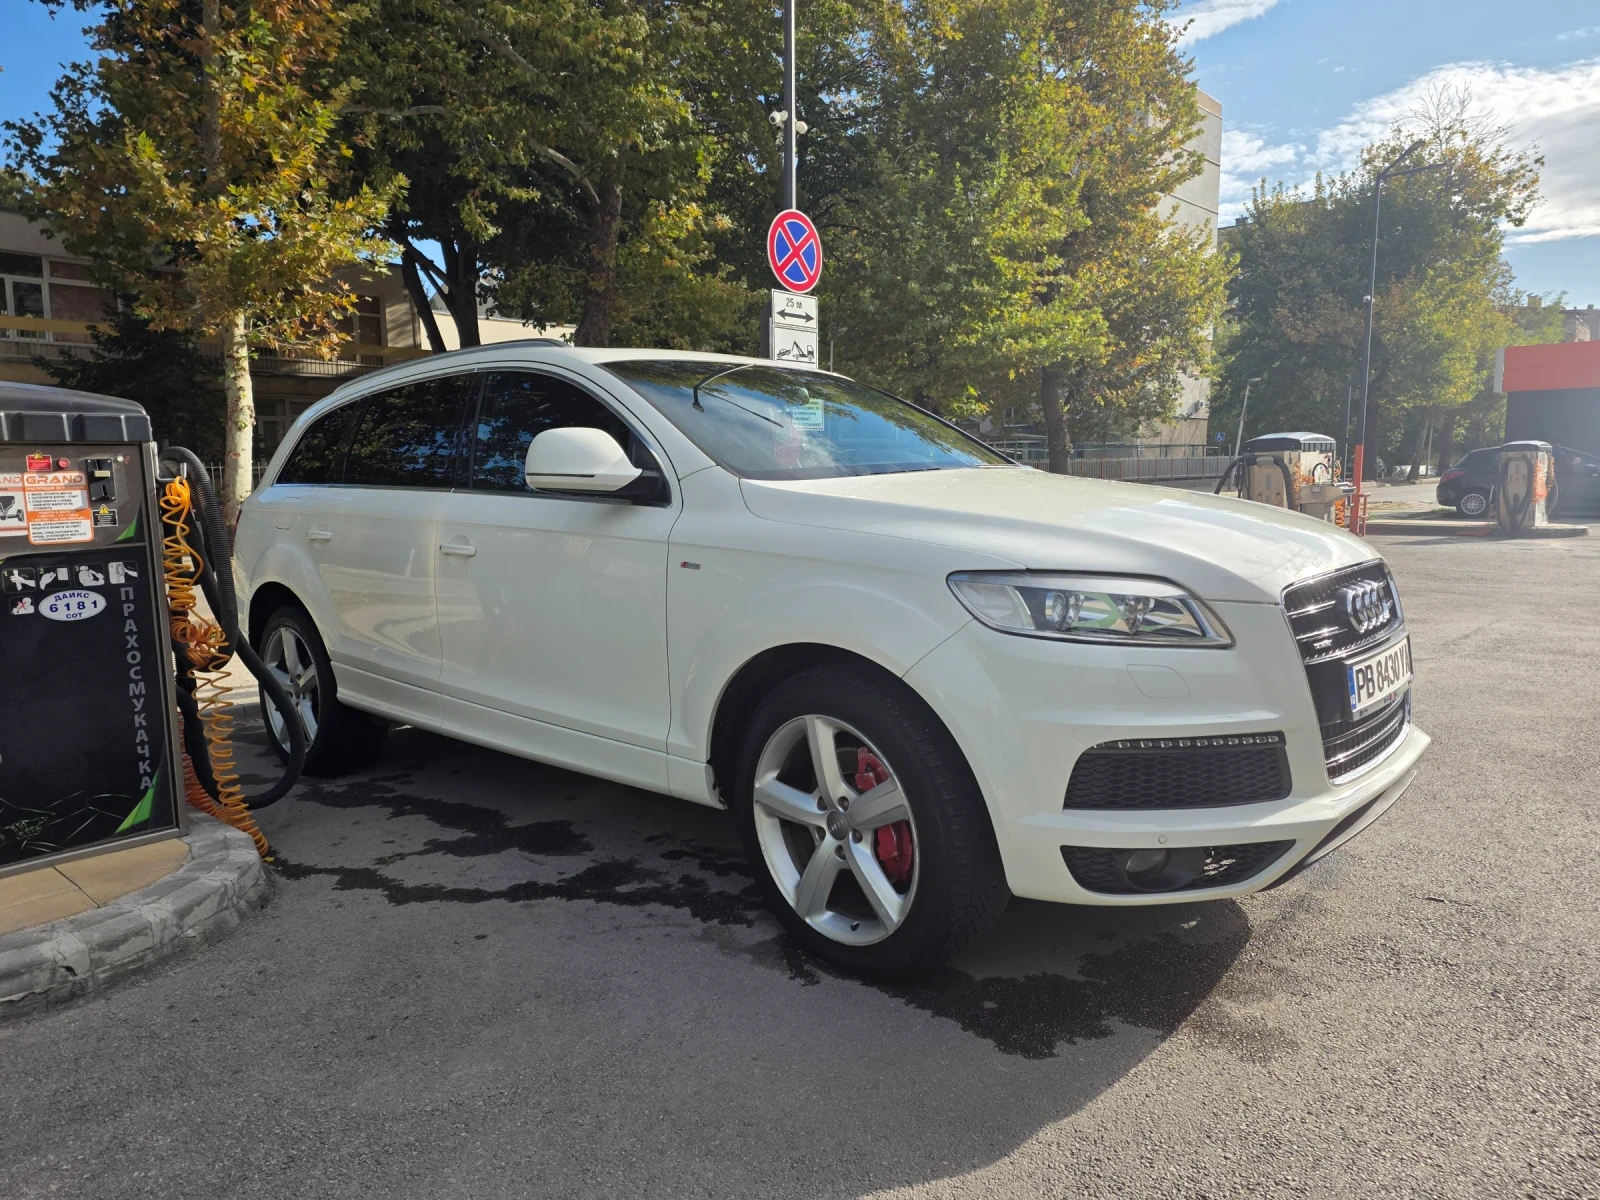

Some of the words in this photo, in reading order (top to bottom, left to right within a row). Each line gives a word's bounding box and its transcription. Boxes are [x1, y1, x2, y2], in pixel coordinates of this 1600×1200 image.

[786, 298, 795, 308] 25
[0, 476, 21, 484] ND
[26, 475, 83, 484] GRAND
[120, 586, 154, 790] ПРАХОСМУКАЧКА
